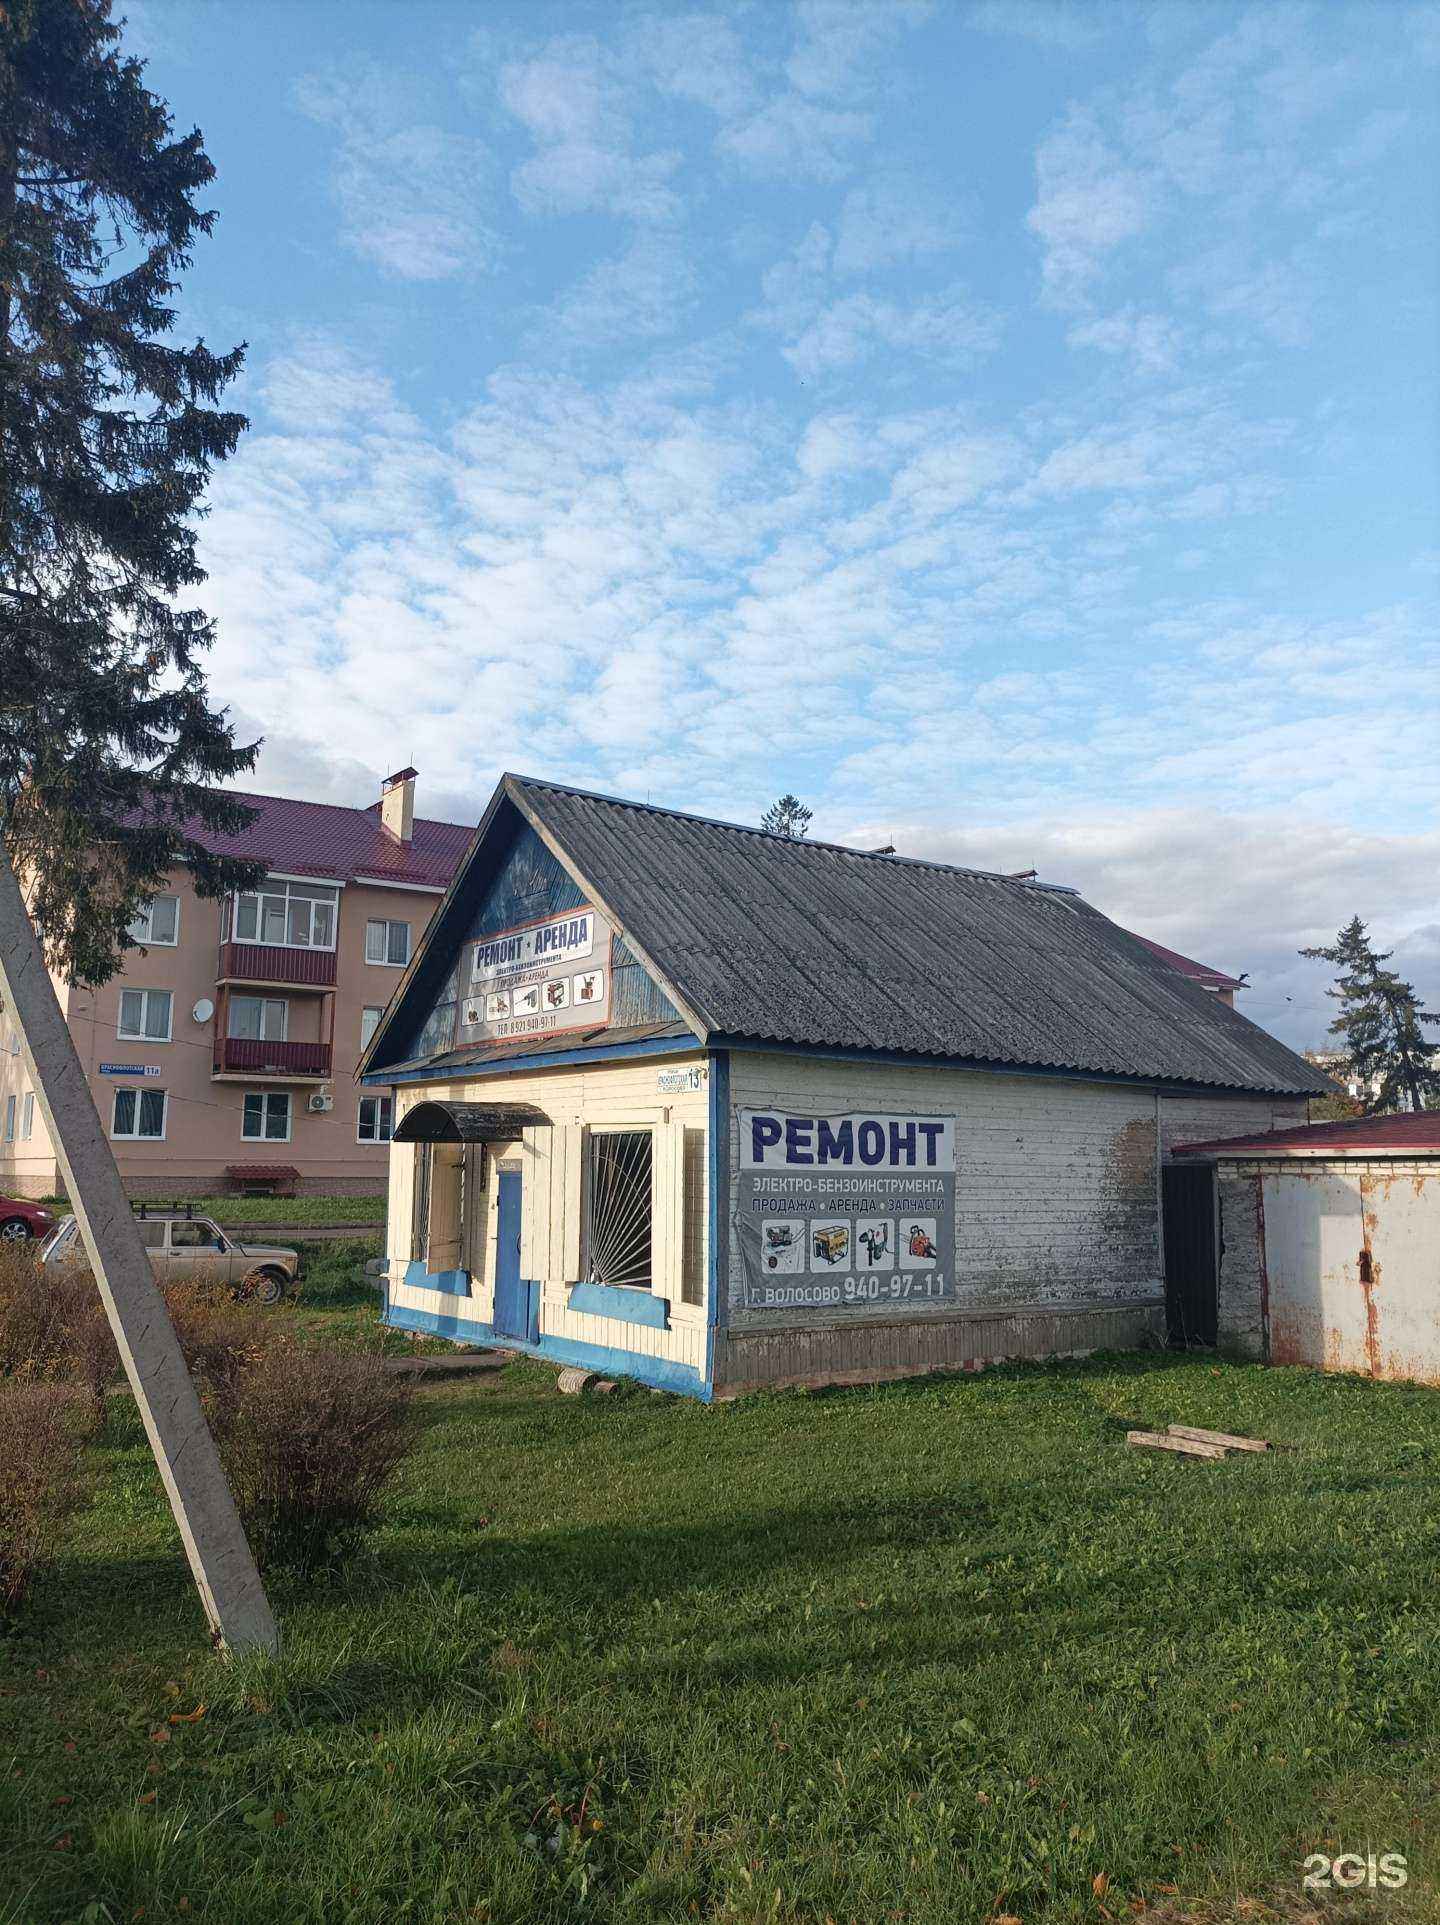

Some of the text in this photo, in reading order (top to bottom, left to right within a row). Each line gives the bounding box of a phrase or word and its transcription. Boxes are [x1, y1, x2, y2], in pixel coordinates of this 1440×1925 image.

[477, 917, 588, 969] РЕМОНТ АРЕНДА
[689, 1069, 699, 1088] 13
[752, 1117, 945, 1166] РЕМОНТ
[753, 1177, 945, 1193] ЭЛЕКТРО-БЕНЗОИНСТРУМЕНТА
[752, 1199, 945, 1213] ПРОДАЖА АРЕНДА ЗАПЧАСТИ
[765, 1286, 841, 1302] ВОЛОСОВО
[843, 1274, 945, 1299] 940-97-11
